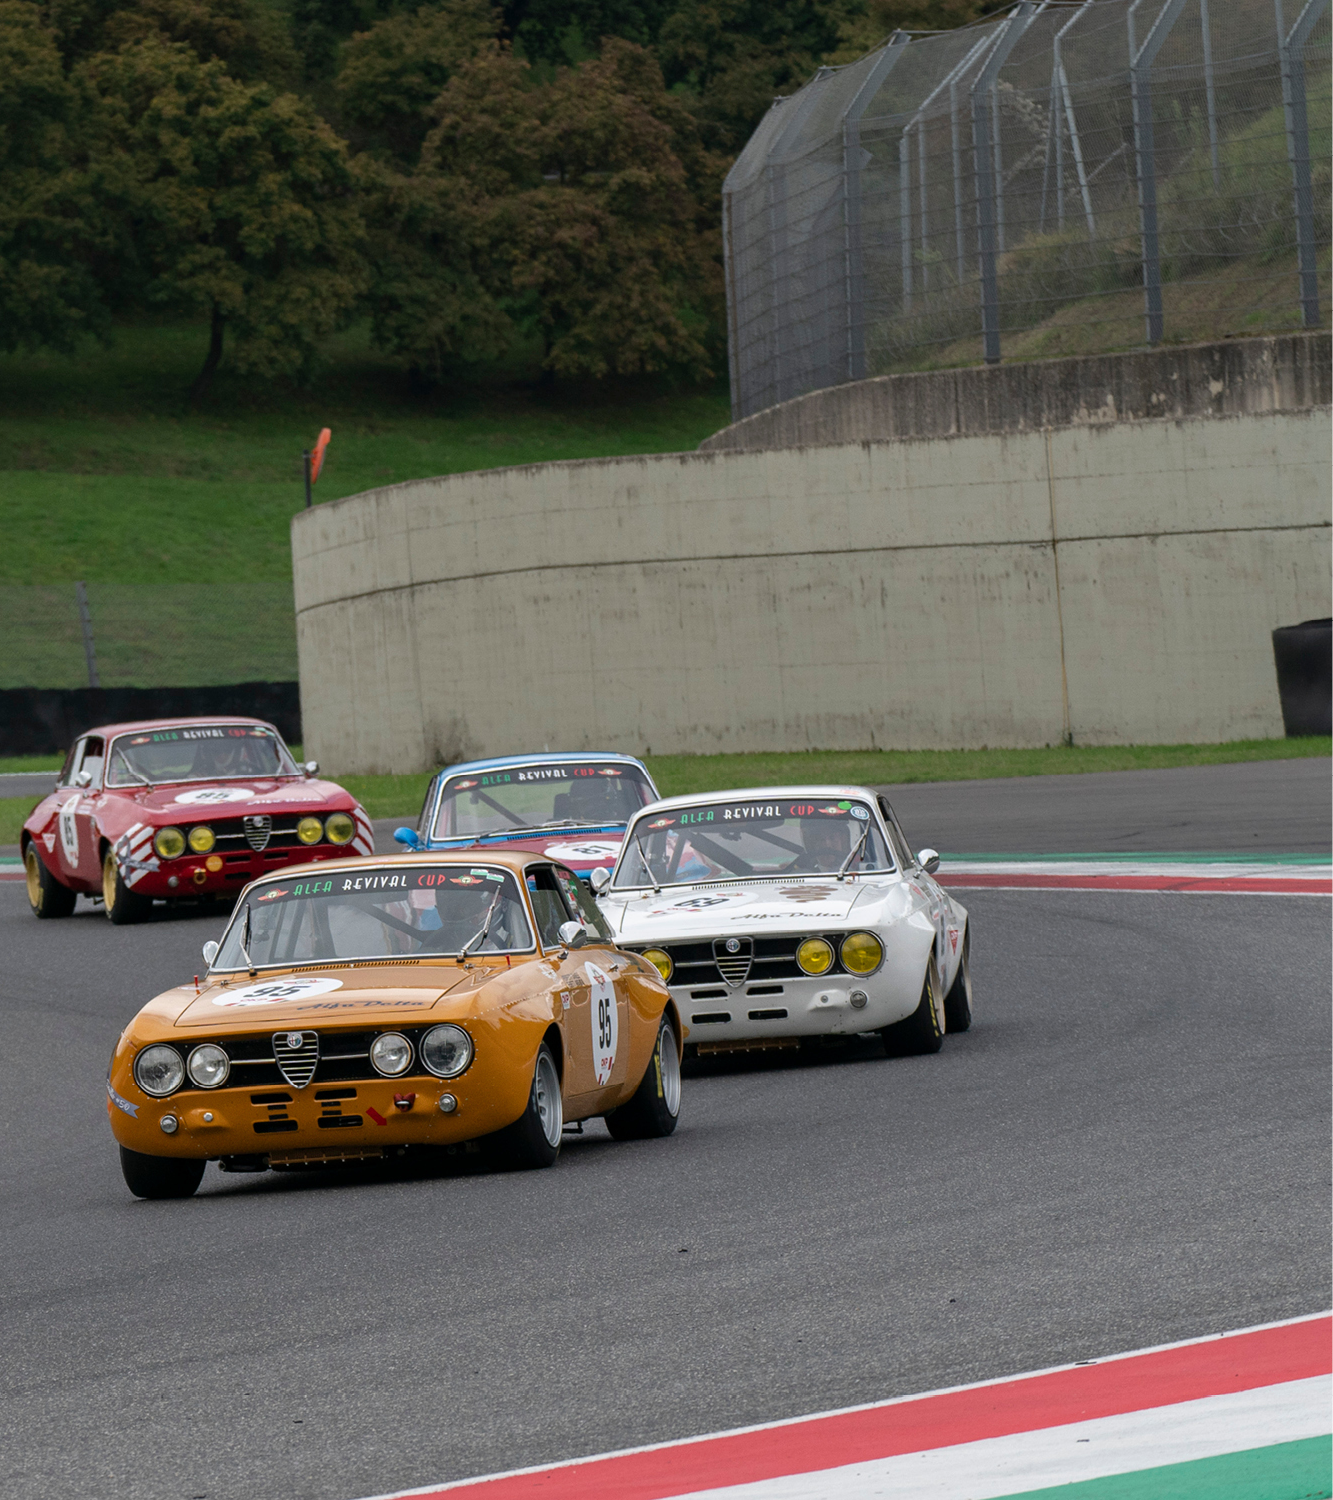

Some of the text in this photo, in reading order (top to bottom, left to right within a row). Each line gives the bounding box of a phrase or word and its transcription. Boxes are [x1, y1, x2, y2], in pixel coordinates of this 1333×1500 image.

[153, 729, 246, 742] ALFA REVIVAL CUP
[481, 768, 595, 785] ALFA REVIVAL CUP
[680, 805, 815, 824] ALFA REVIVAL CUP
[572, 845, 615, 855] 81
[292, 874, 446, 896] ALFA REVIVAL CUP
[674, 897, 730, 908] 69
[243, 985, 311, 998] 95
[296, 1002, 355, 1011] Alfa
[598, 998, 612, 1050] 95
